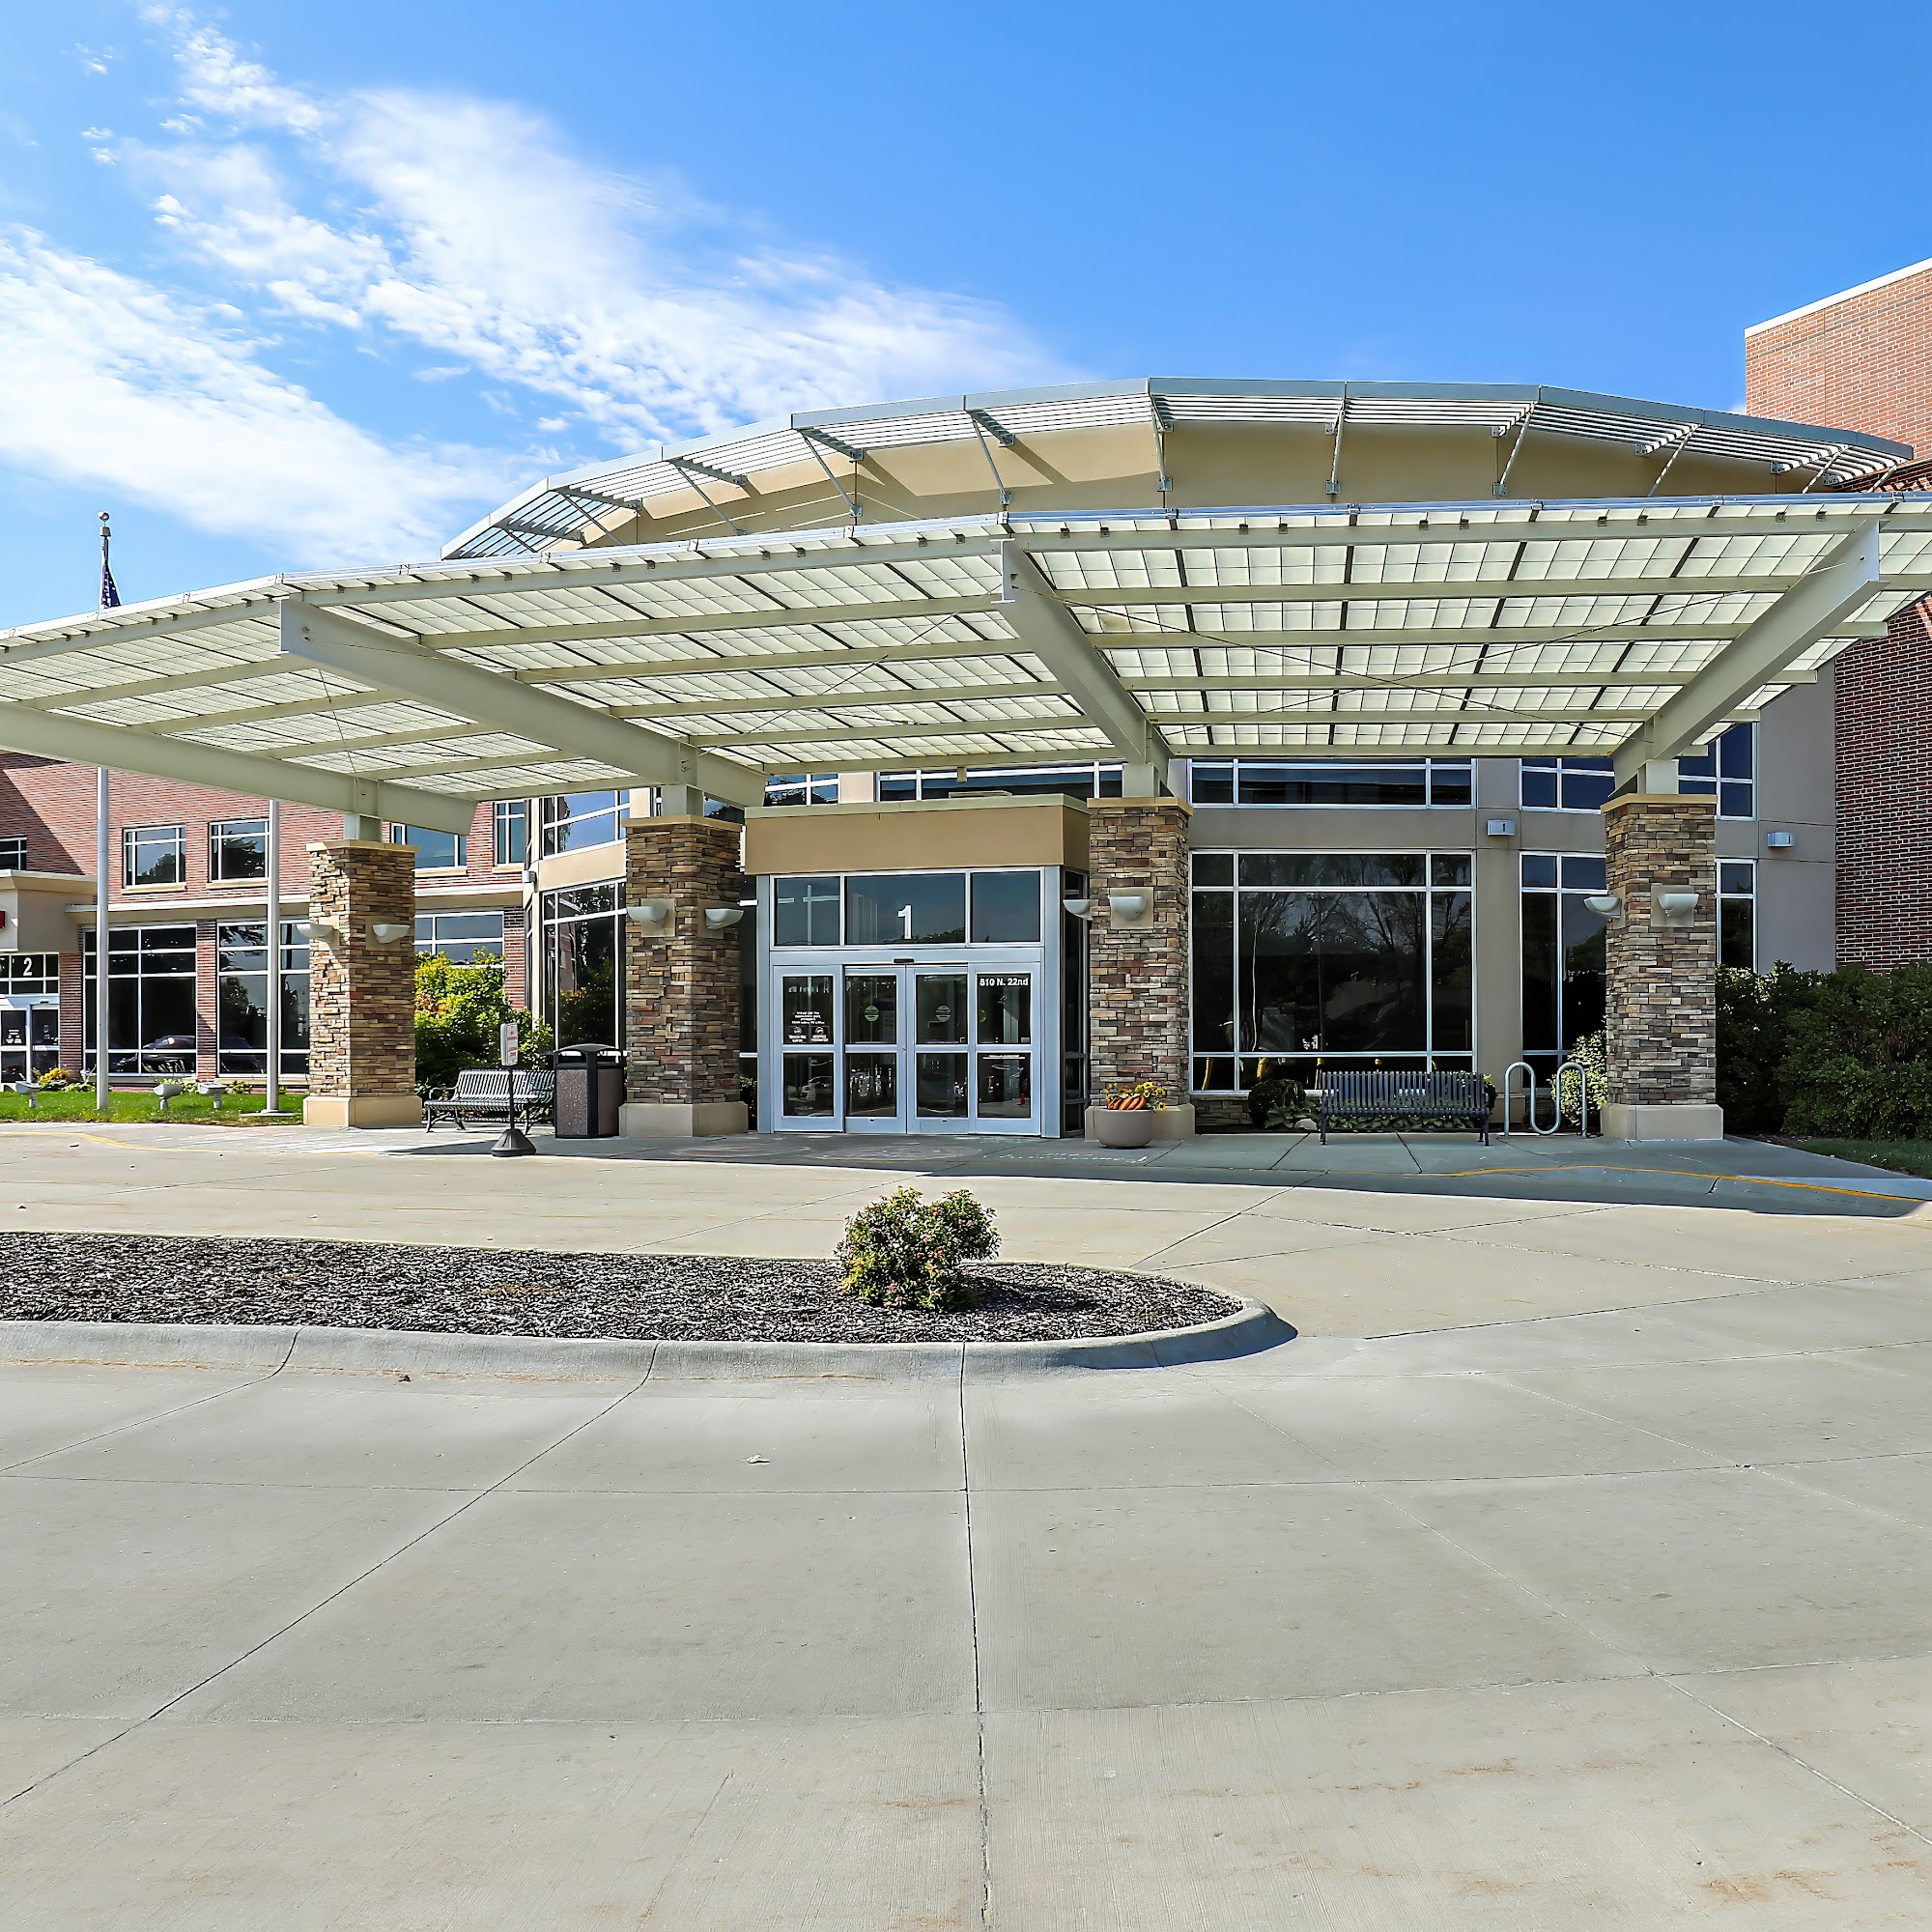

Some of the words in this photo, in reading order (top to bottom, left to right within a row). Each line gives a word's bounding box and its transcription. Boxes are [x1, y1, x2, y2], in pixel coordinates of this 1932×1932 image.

[897, 904, 912, 940] 1
[23, 957, 33, 977] 2
[980, 978, 995, 986] 810
[996, 978, 1007, 986] N.
[1007, 977, 1029, 986] 22nd
